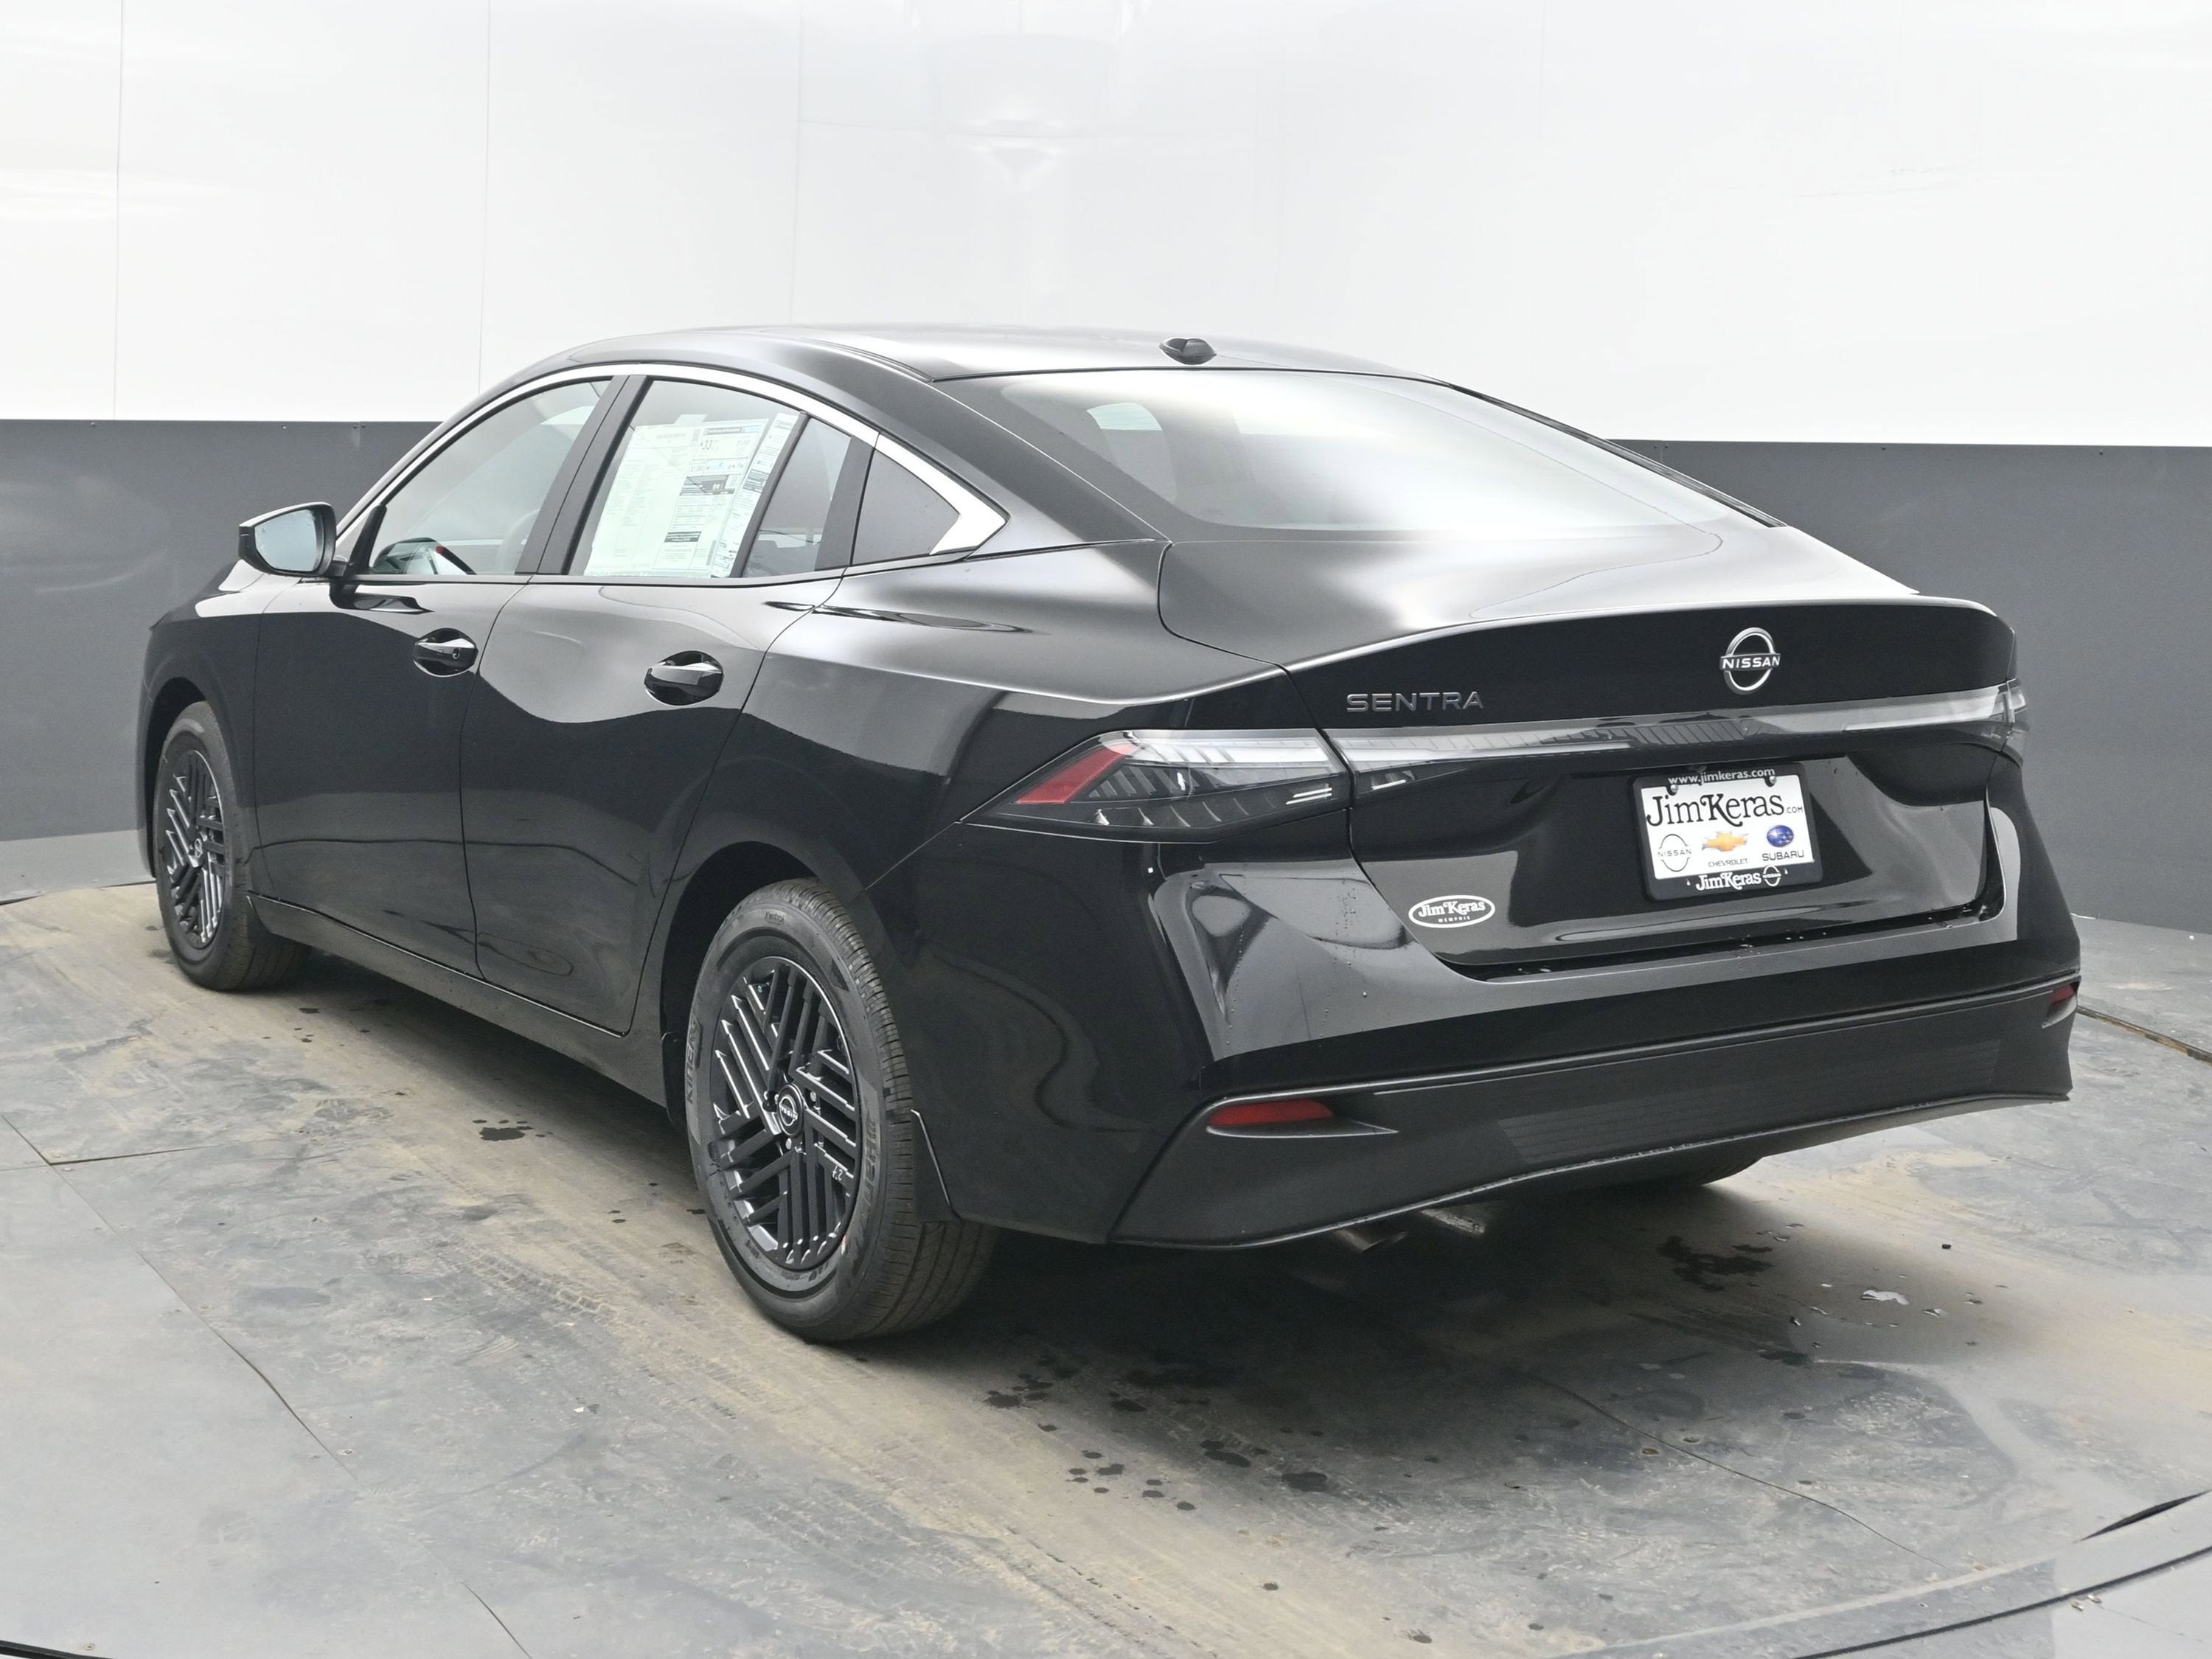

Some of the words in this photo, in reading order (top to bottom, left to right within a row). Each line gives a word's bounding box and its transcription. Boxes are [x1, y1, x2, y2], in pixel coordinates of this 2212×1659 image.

[1722, 655, 1781, 669] NISSAN
[1346, 691, 1484, 712] SENTRA
[1668, 768, 1775, 785] www.jimkeras.com
[1658, 849, 1691, 857] NISSAN
[1761, 849, 1805, 861] SUBARU
[1708, 858, 1749, 868] CHEVROLET
